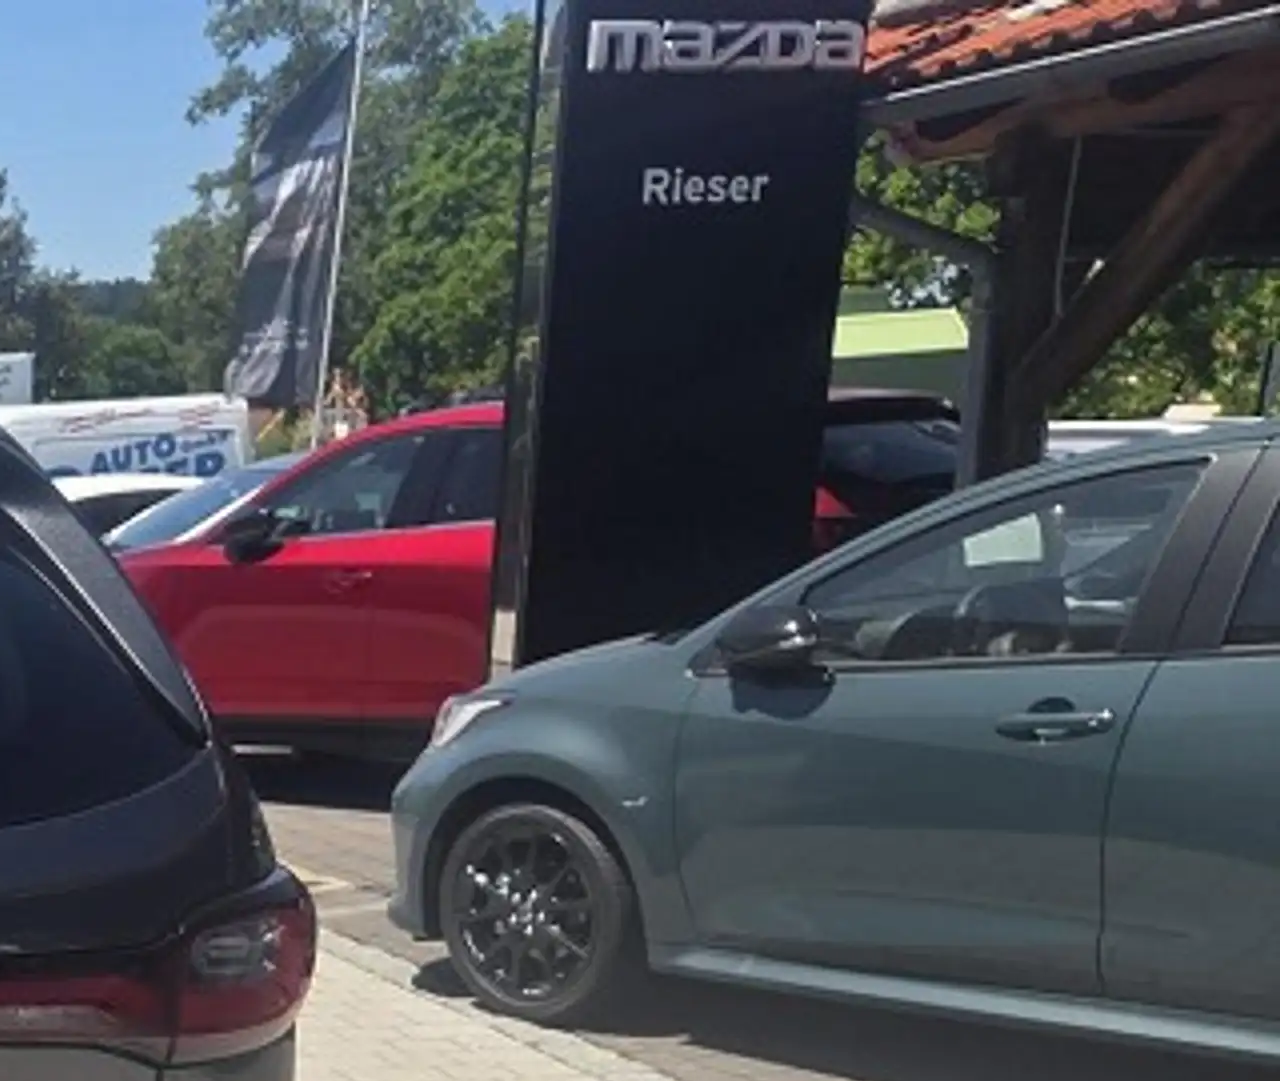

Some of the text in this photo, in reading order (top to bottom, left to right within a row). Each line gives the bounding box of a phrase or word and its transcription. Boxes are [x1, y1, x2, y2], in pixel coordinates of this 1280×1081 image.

[587, 19, 864, 72] mazda
[642, 167, 770, 205] Rieser
[91, 432, 177, 474] AUTO
